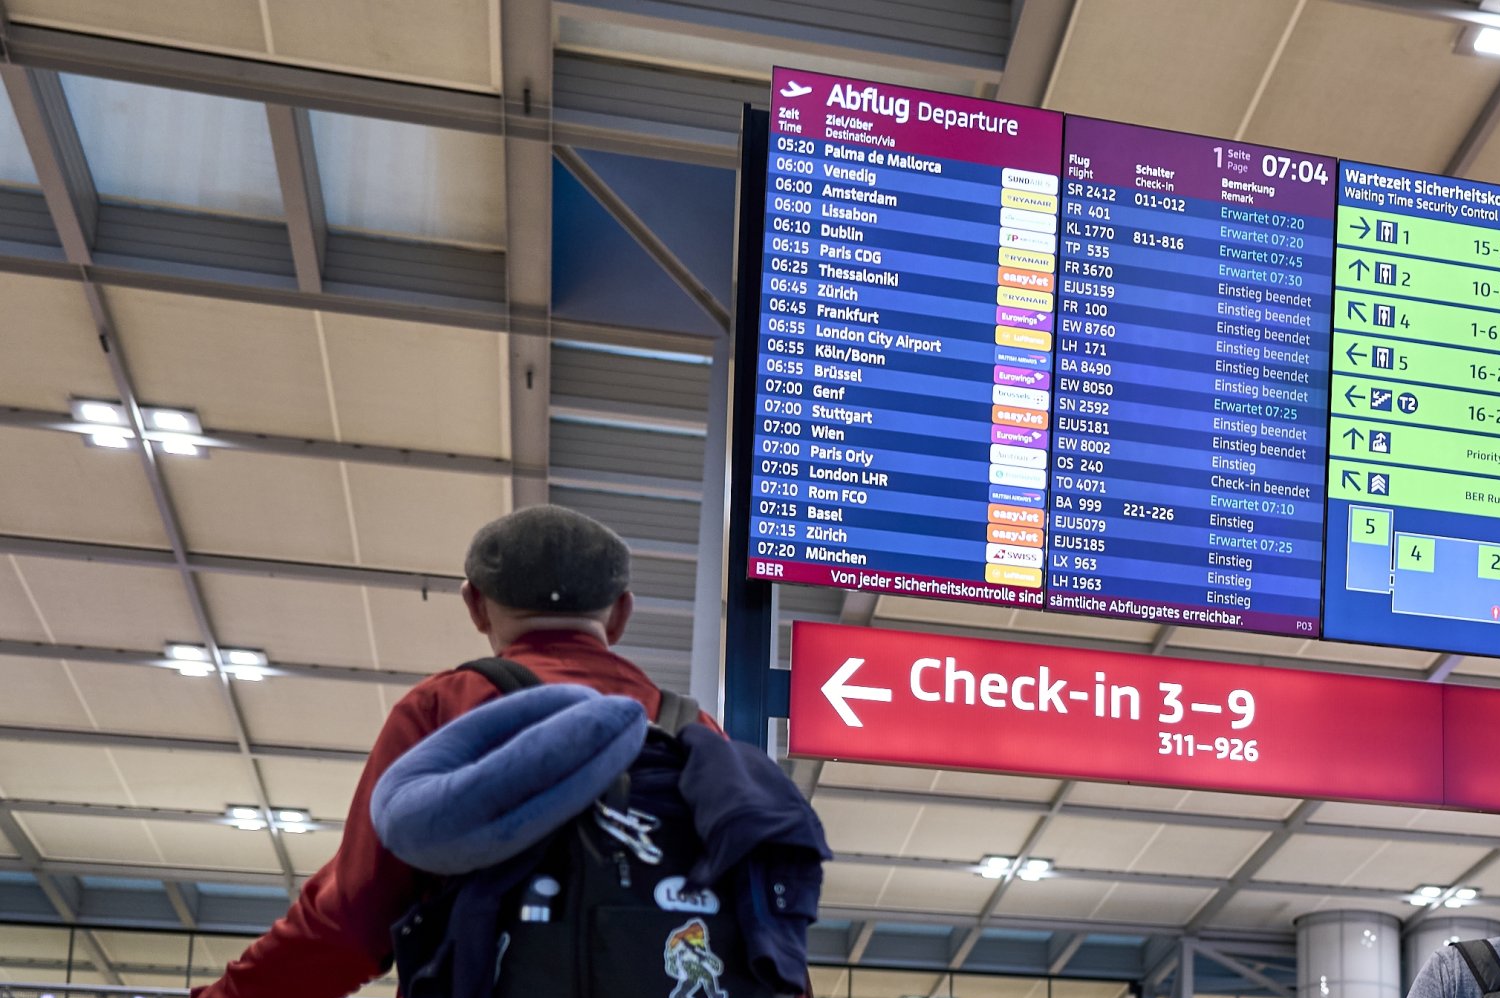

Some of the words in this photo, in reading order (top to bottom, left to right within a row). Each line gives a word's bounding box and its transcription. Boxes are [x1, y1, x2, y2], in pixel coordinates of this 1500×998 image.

[778, 106, 799, 120] Zeit
[826, 83, 910, 124] Abflug
[918, 101, 1018, 136] Departure
[778, 120, 802, 134] Time
[825, 114, 873, 131] Ziel/über
[825, 127, 895, 147] Destination/via
[777, 137, 815, 154] 05:20
[824, 143, 865, 162] Palma
[867, 149, 884, 165] de
[887, 153, 942, 173] Mallorca
[1069, 153, 1090, 168] Flug
[1213, 146, 1222, 168] 1
[1227, 148, 1251, 161] Seite
[776, 157, 814, 174] 06:00
[823, 163, 876, 186] Venedig
[1135, 164, 1175, 179] Schalter
[1227, 161, 1248, 174] Page
[1262, 154, 1328, 185] 07:04
[1221, 177, 1275, 197] Bemerkung
[1345, 168, 1411, 192] Wartezeit
[1067, 182, 1083, 196] SR
[1086, 185, 1116, 201] 2412
[1134, 192, 1185, 212] 011-012
[1221, 206, 1269, 225] Erwartet
[1271, 214, 1304, 230] 07:20
[1344, 186, 1384, 206] Waiting
[1387, 192, 1413, 208] Time
[1416, 197, 1459, 217] Security
[1460, 204, 1498, 221] Control
[1403, 230, 1409, 245] 1
[772, 237, 809, 254] 06:15
[820, 243, 852, 260] Paris
[854, 248, 881, 264] CDG
[771, 257, 808, 274] 06:25
[818, 263, 899, 287] Thessaloniki
[1002, 272, 1049, 287] easyJet
[1401, 271, 1410, 287] 2
[1064, 280, 1115, 298] EJU5159
[1217, 302, 1261, 322] Einstieg
[1264, 308, 1311, 327] beendet
[1400, 314, 1410, 329] 4
[768, 318, 805, 335] 06:55
[816, 323, 865, 342] London
[867, 330, 893, 349] City
[895, 334, 942, 353] Airport
[767, 338, 804, 355] 06:55
[815, 343, 885, 365] Köln/Bonn
[1399, 355, 1408, 371] 5
[1399, 396, 1416, 411] T2
[762, 439, 800, 456] 07:00
[810, 445, 842, 461] Paris
[845, 449, 874, 467] Orly
[1057, 456, 1073, 470] OS
[1080, 458, 1103, 473] 240
[1211, 475, 1260, 492] Check-in
[1263, 480, 1310, 498] beendet
[760, 480, 798, 496] 07:10
[808, 485, 838, 501] Rom
[841, 489, 867, 504] FCO
[1465, 491, 1485, 501] BER
[1055, 495, 1073, 509] BA
[1078, 498, 1102, 512] 999
[1123, 503, 1174, 521] 221-226
[1209, 513, 1254, 532] Einstieg
[757, 541, 795, 557] 07:20
[805, 546, 867, 565] München
[1007, 552, 1037, 561] SWISS
[756, 561, 784, 577] BER
[830, 569, 856, 584] Von
[857, 571, 892, 588] jeder
[894, 576, 1016, 601] Sicherheitskontrolle
[1018, 589, 1044, 604] sind
[1049, 594, 1106, 611] sämtliche
[1109, 599, 1180, 619] Abfluggates
[1182, 609, 1243, 625] erreichbar.
[911, 658, 1138, 719] Check-in
